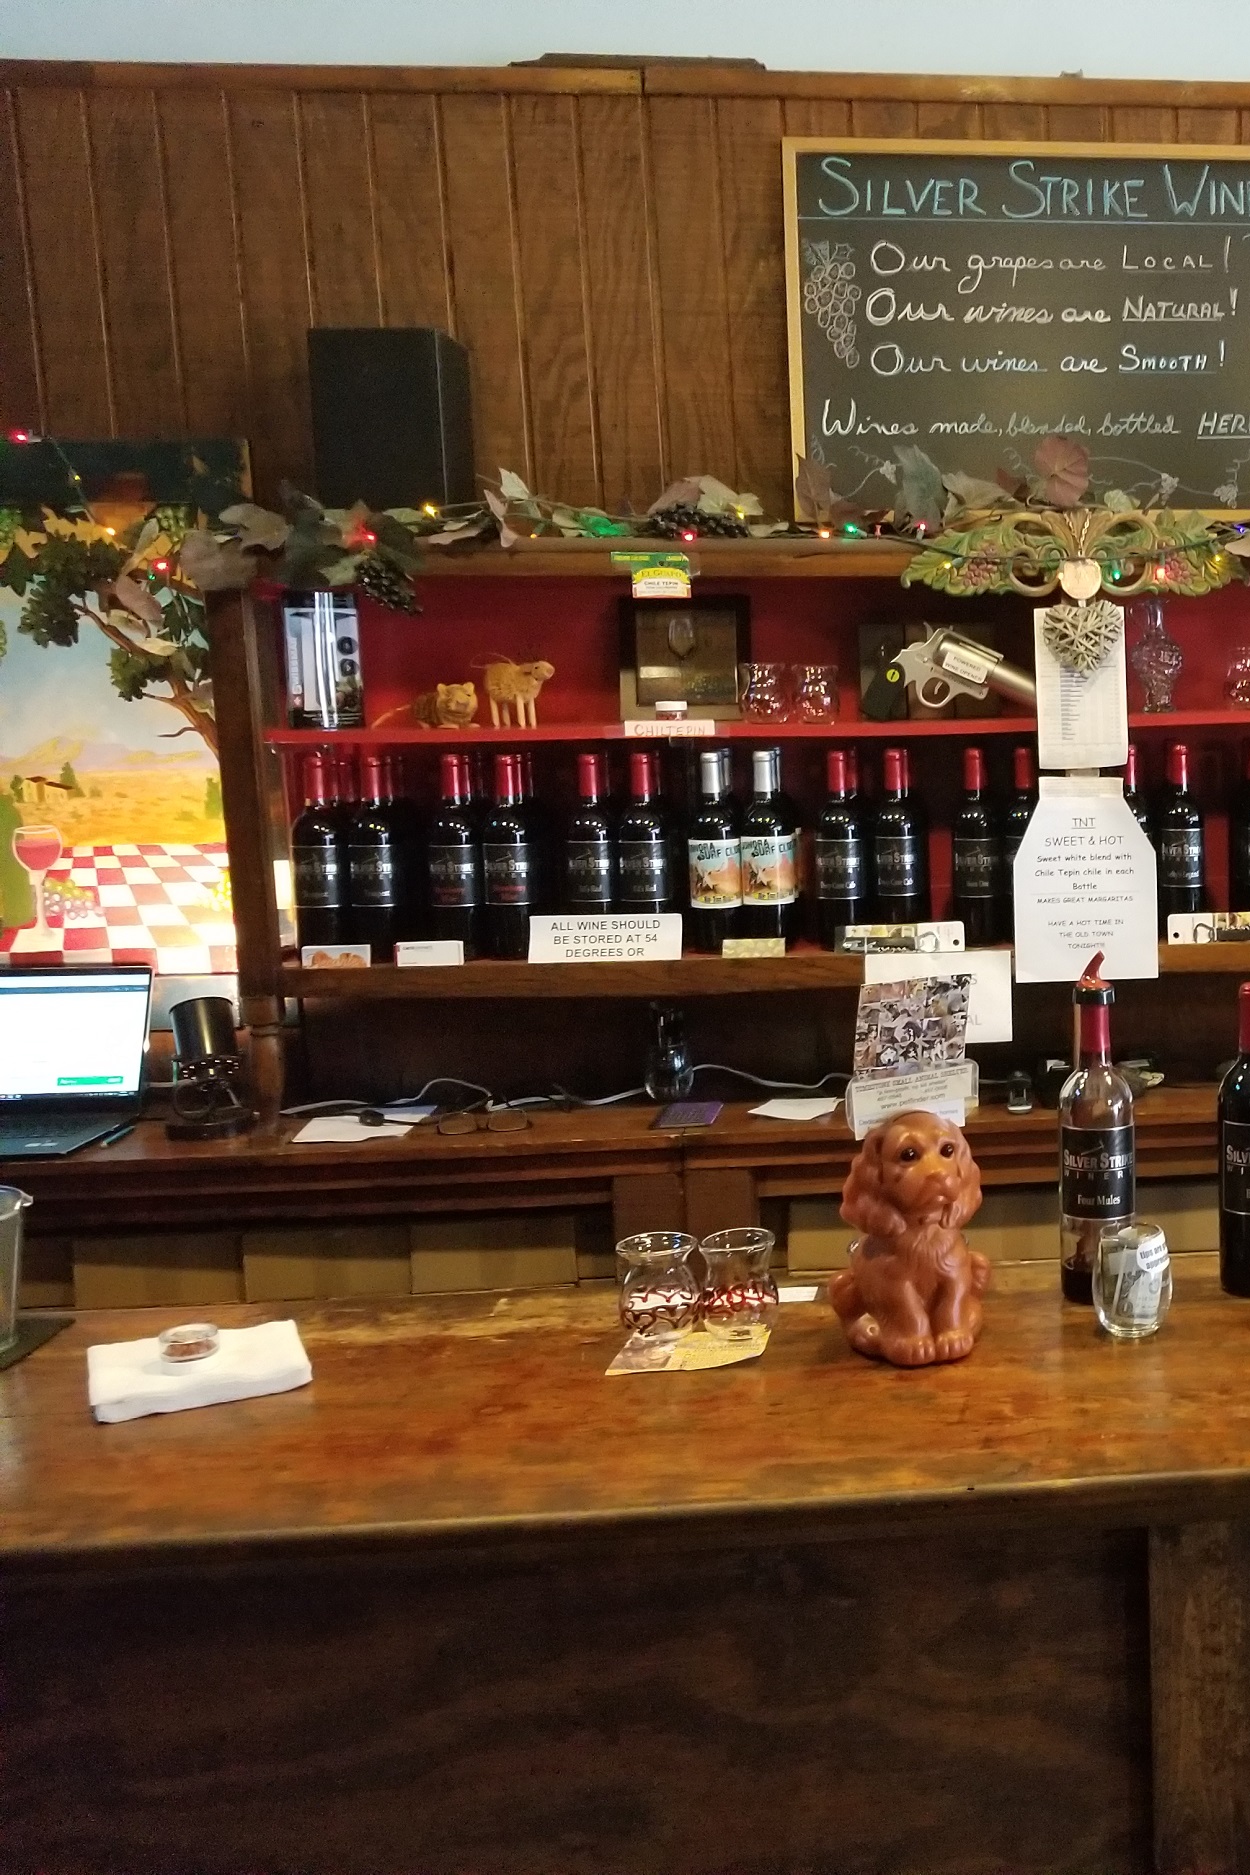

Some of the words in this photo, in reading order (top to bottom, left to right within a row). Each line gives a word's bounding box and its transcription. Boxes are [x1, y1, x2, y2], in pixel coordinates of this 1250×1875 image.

[819, 157, 986, 216] SILVER
[1002, 160, 1147, 218] STRIKE
[871, 241, 950, 273] Our
[957, 253, 1055, 294] grapes
[1058, 256, 1106, 272] are
[866, 287, 954, 325] Our
[964, 301, 1055, 324] wines
[1062, 308, 1110, 323] are
[871, 343, 947, 376] Our
[961, 350, 1047, 373] wines
[1061, 355, 1107, 373] are
[822, 398, 918, 437] Wines
[1097, 411, 1182, 437] bottled
[653, 569, 682, 579] GUAPO
[634, 724, 706, 737] CHILTEPIN
[1071, 817, 1096, 829] TNT
[1044, 836, 1085, 847] SWEET
[1089, 836, 1096, 846] &
[1099, 835, 1124, 846] HOT
[1037, 855, 1061, 863] Sweet
[1065, 854, 1086, 862] white
[1090, 853, 1111, 861] blend
[1115, 853, 1132, 861] with
[1035, 869, 1054, 877] Chile
[1058, 868, 1080, 878] Tepin
[1083, 868, 1102, 876] chile
[1115, 867, 1134, 875] each
[1072, 882, 1097, 891] Bottle
[1088, 895, 1133, 903] MARGARITAS
[550, 921, 574, 931] ALL
[577, 920, 607, 931] WINE
[611, 919, 660, 930] SHOULD
[553, 935, 570, 945] BE
[573, 934, 623, 945] STORED
[626, 934, 642, 944] AT
[645, 933, 658, 943] 54
[565, 947, 622, 959] DEGREES
[626, 947, 645, 957] OR
[1064, 1149, 1098, 1169] SILVER
[1100, 1150, 1133, 1169] STRIKE
[1077, 1194, 1095, 1205] Four
[1096, 1194, 1121, 1206] Mules
[1140, 1247, 1153, 1260] tips
